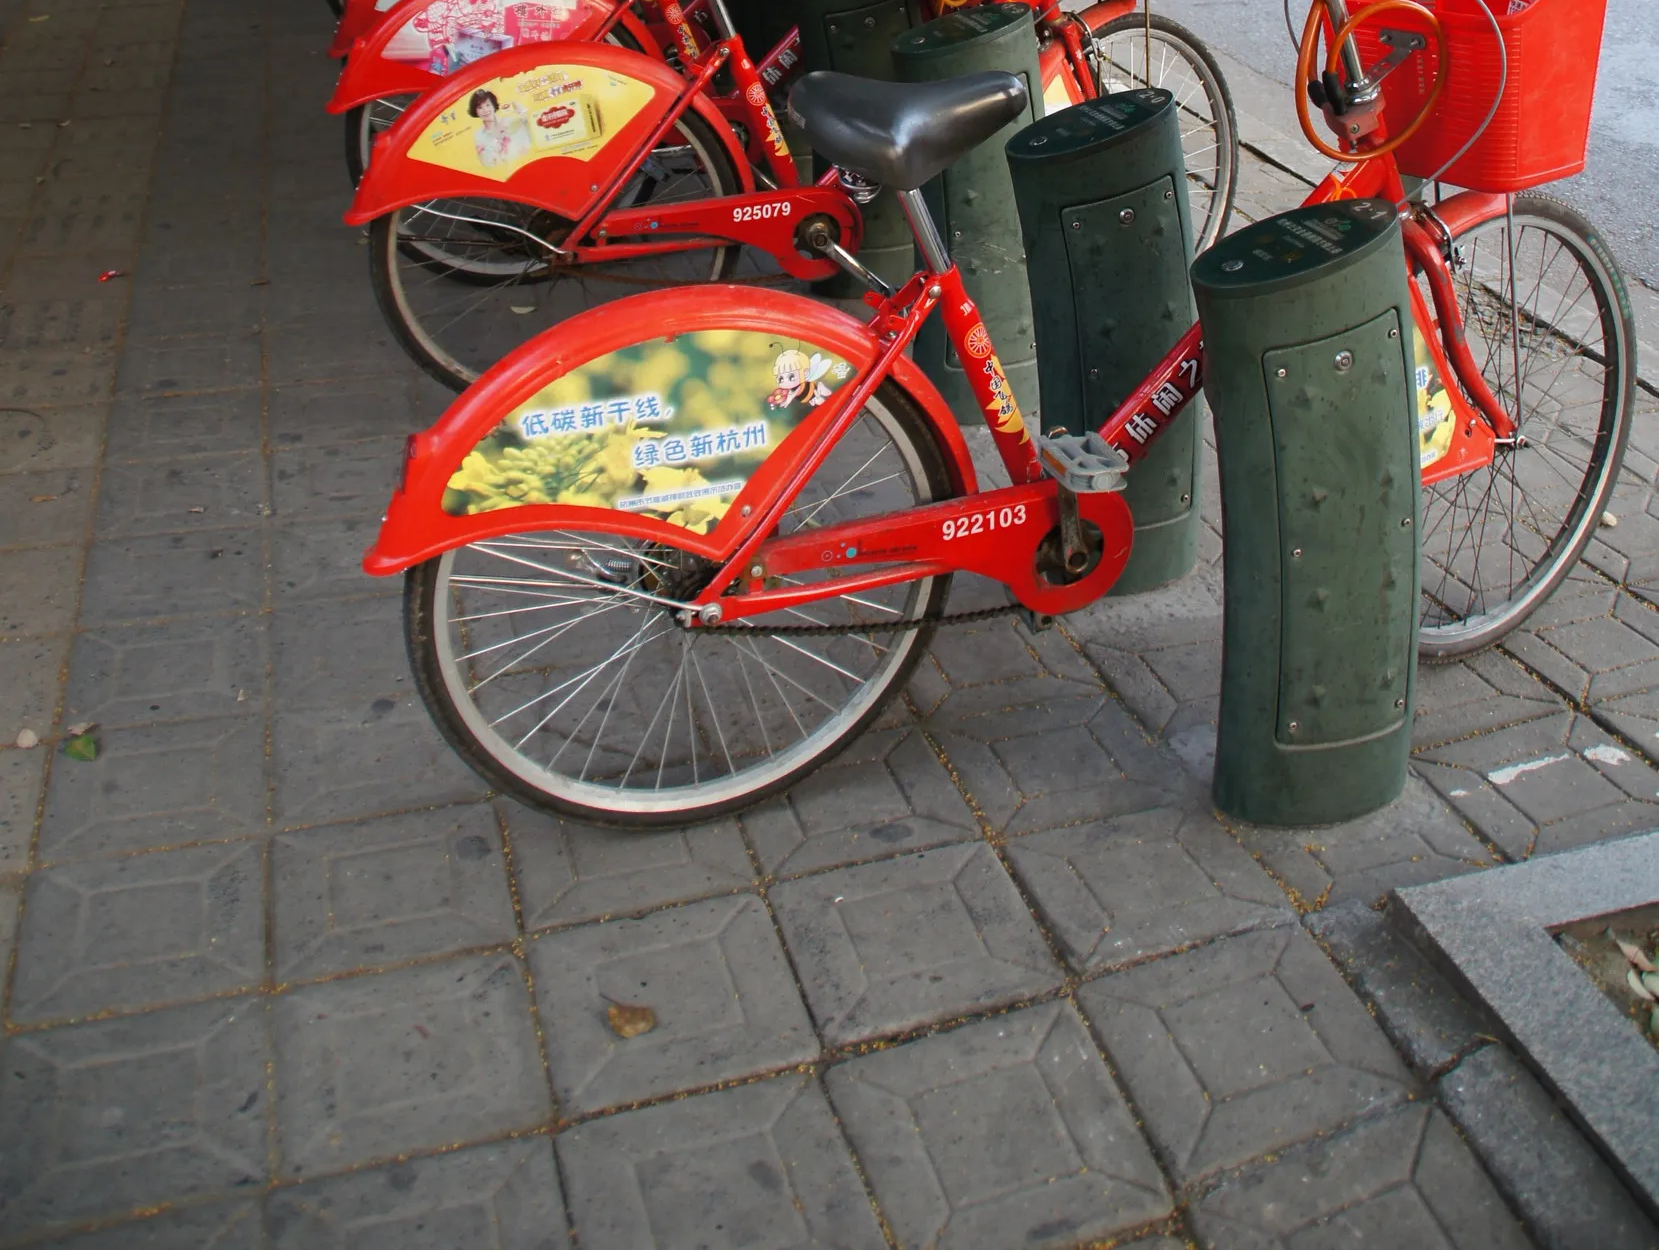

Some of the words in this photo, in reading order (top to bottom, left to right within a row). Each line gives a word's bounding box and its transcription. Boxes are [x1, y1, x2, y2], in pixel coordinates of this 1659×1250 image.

[733, 201, 791, 222] 925079
[633, 424, 767, 466] 绿色新杭州
[942, 504, 1027, 541] 922103
